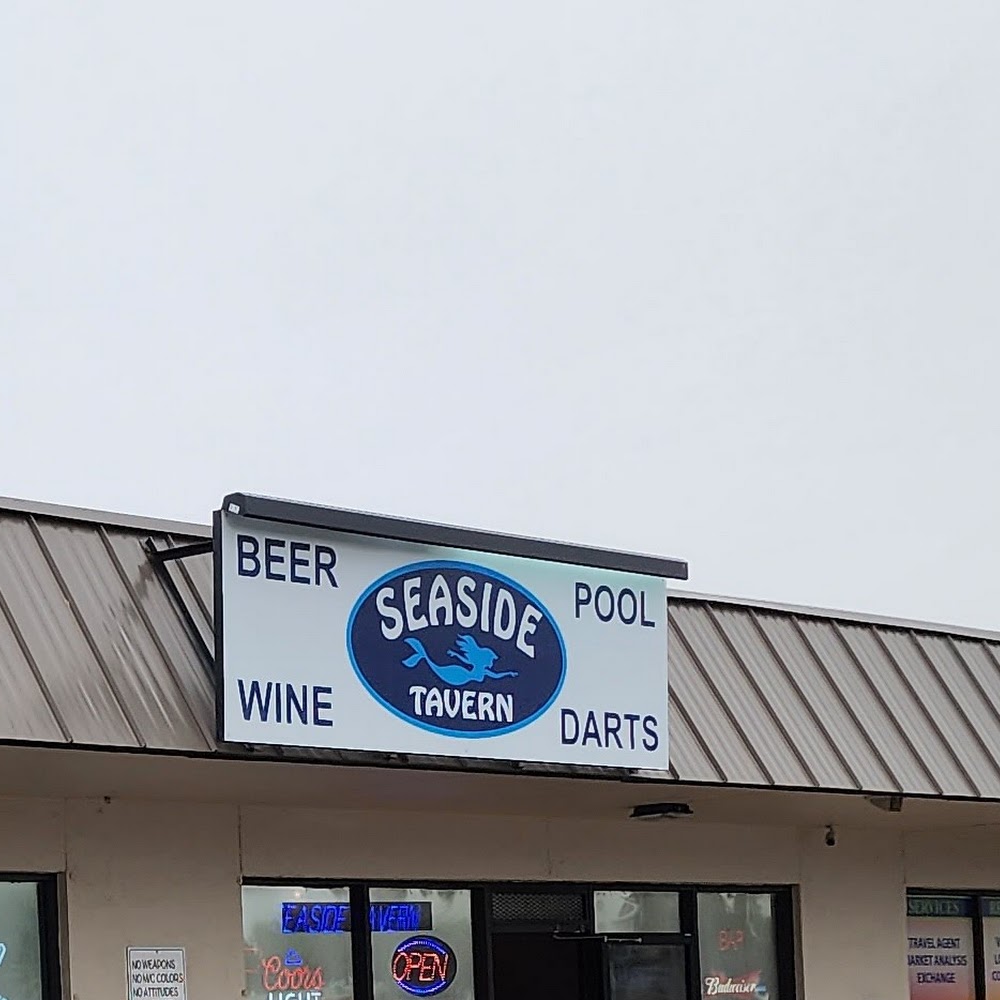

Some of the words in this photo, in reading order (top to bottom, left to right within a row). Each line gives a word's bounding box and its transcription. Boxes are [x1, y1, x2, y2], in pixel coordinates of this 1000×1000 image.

[236, 533, 339, 588] BEER
[376, 573, 544, 659] SEASIDE
[573, 581, 657, 629] POOL
[236, 678, 335, 728] WINE
[409, 685, 515, 723] TAVERN
[559, 708, 660, 752] DARTS
[908, 899, 960, 915] SERVICES
[907, 937, 936, 949] TRAVEL
[937, 938, 961, 949] AGENT
[132, 960, 141, 970] NO
[142, 959, 176, 970] WEAPONS
[262, 955, 325, 990] Coors
[391, 952, 449, 983] OPEN
[934, 955, 968, 966] ANALYSIS
[132, 974, 142, 984] NO
[156, 973, 184, 984] COLORS
[133, 988, 143, 998] NO
[144, 987, 179, 998] ATTITUDES
[916, 972, 957, 983] EXCHANGE
